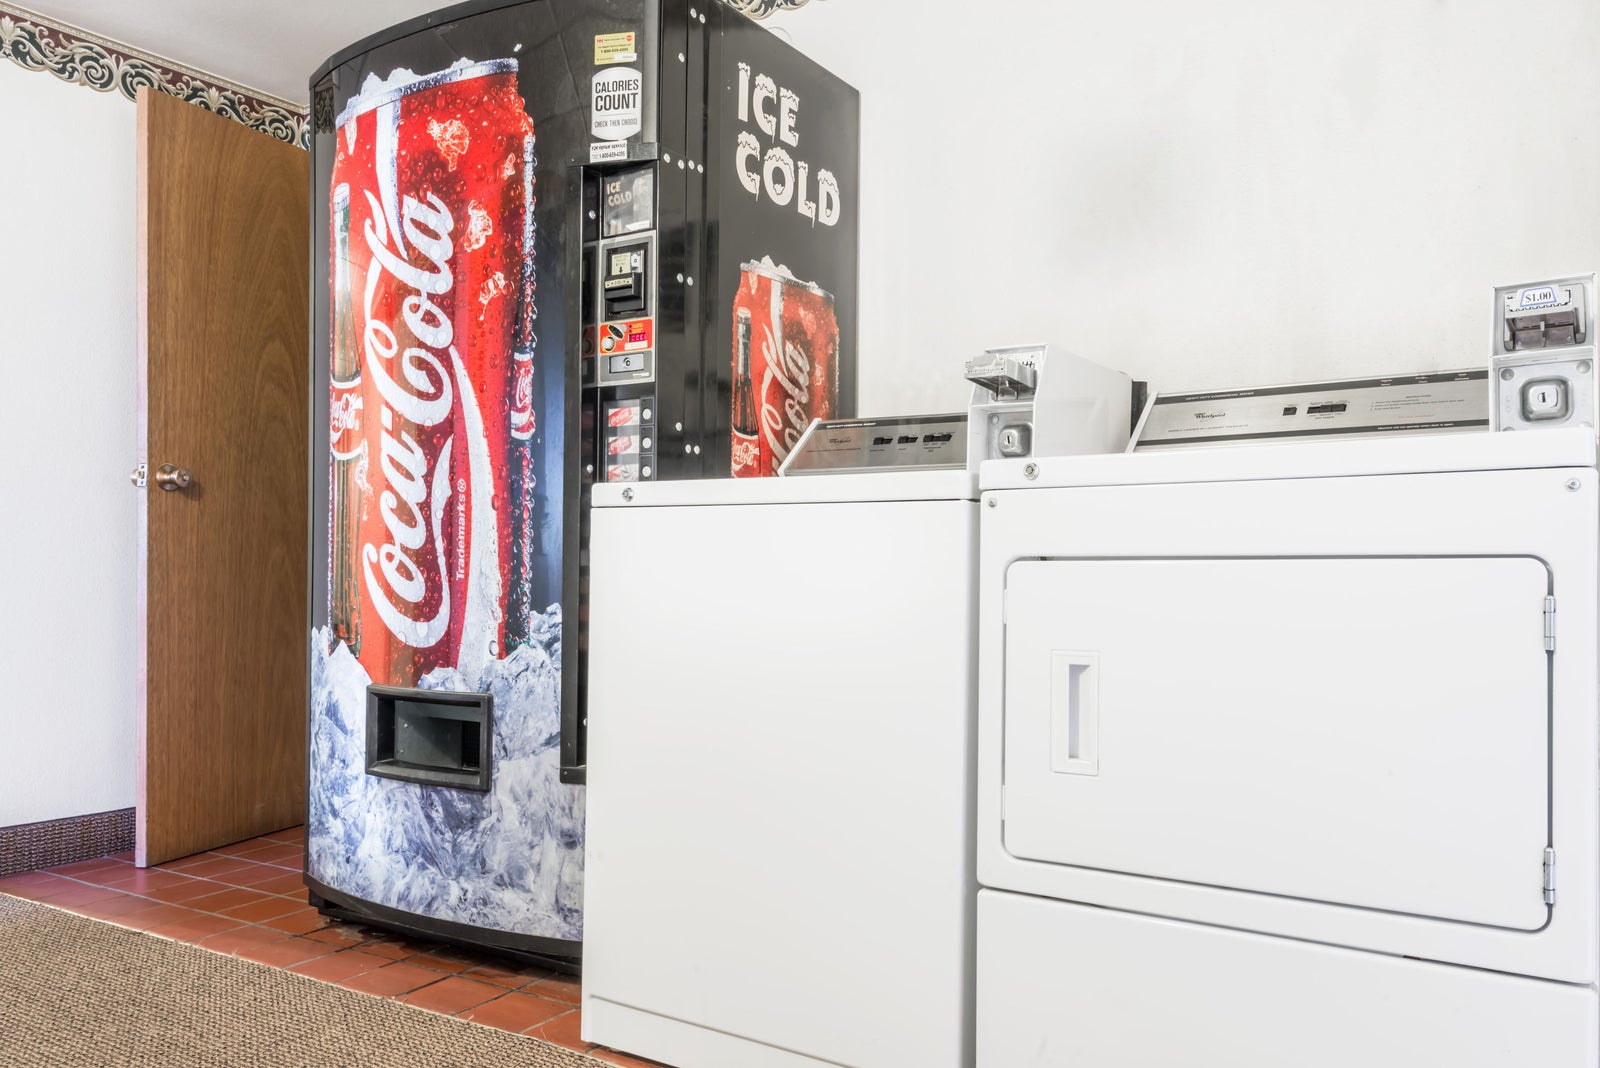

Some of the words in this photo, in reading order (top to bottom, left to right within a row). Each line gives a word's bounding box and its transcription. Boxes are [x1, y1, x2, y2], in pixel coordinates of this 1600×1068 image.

[595, 79, 639, 94] CALORIES
[595, 92, 639, 112] COUNT
[738, 62, 800, 147] ICE
[594, 120, 608, 128] CHECK
[610, 119, 621, 127] THEN
[621, 118, 638, 126] CHOOSE
[606, 181, 621, 195] ICE
[736, 131, 841, 229] COLD
[608, 191, 632, 207] COLD
[1525, 291, 1552, 303] $1.00
[363, 190, 455, 648] Coca-Cola
